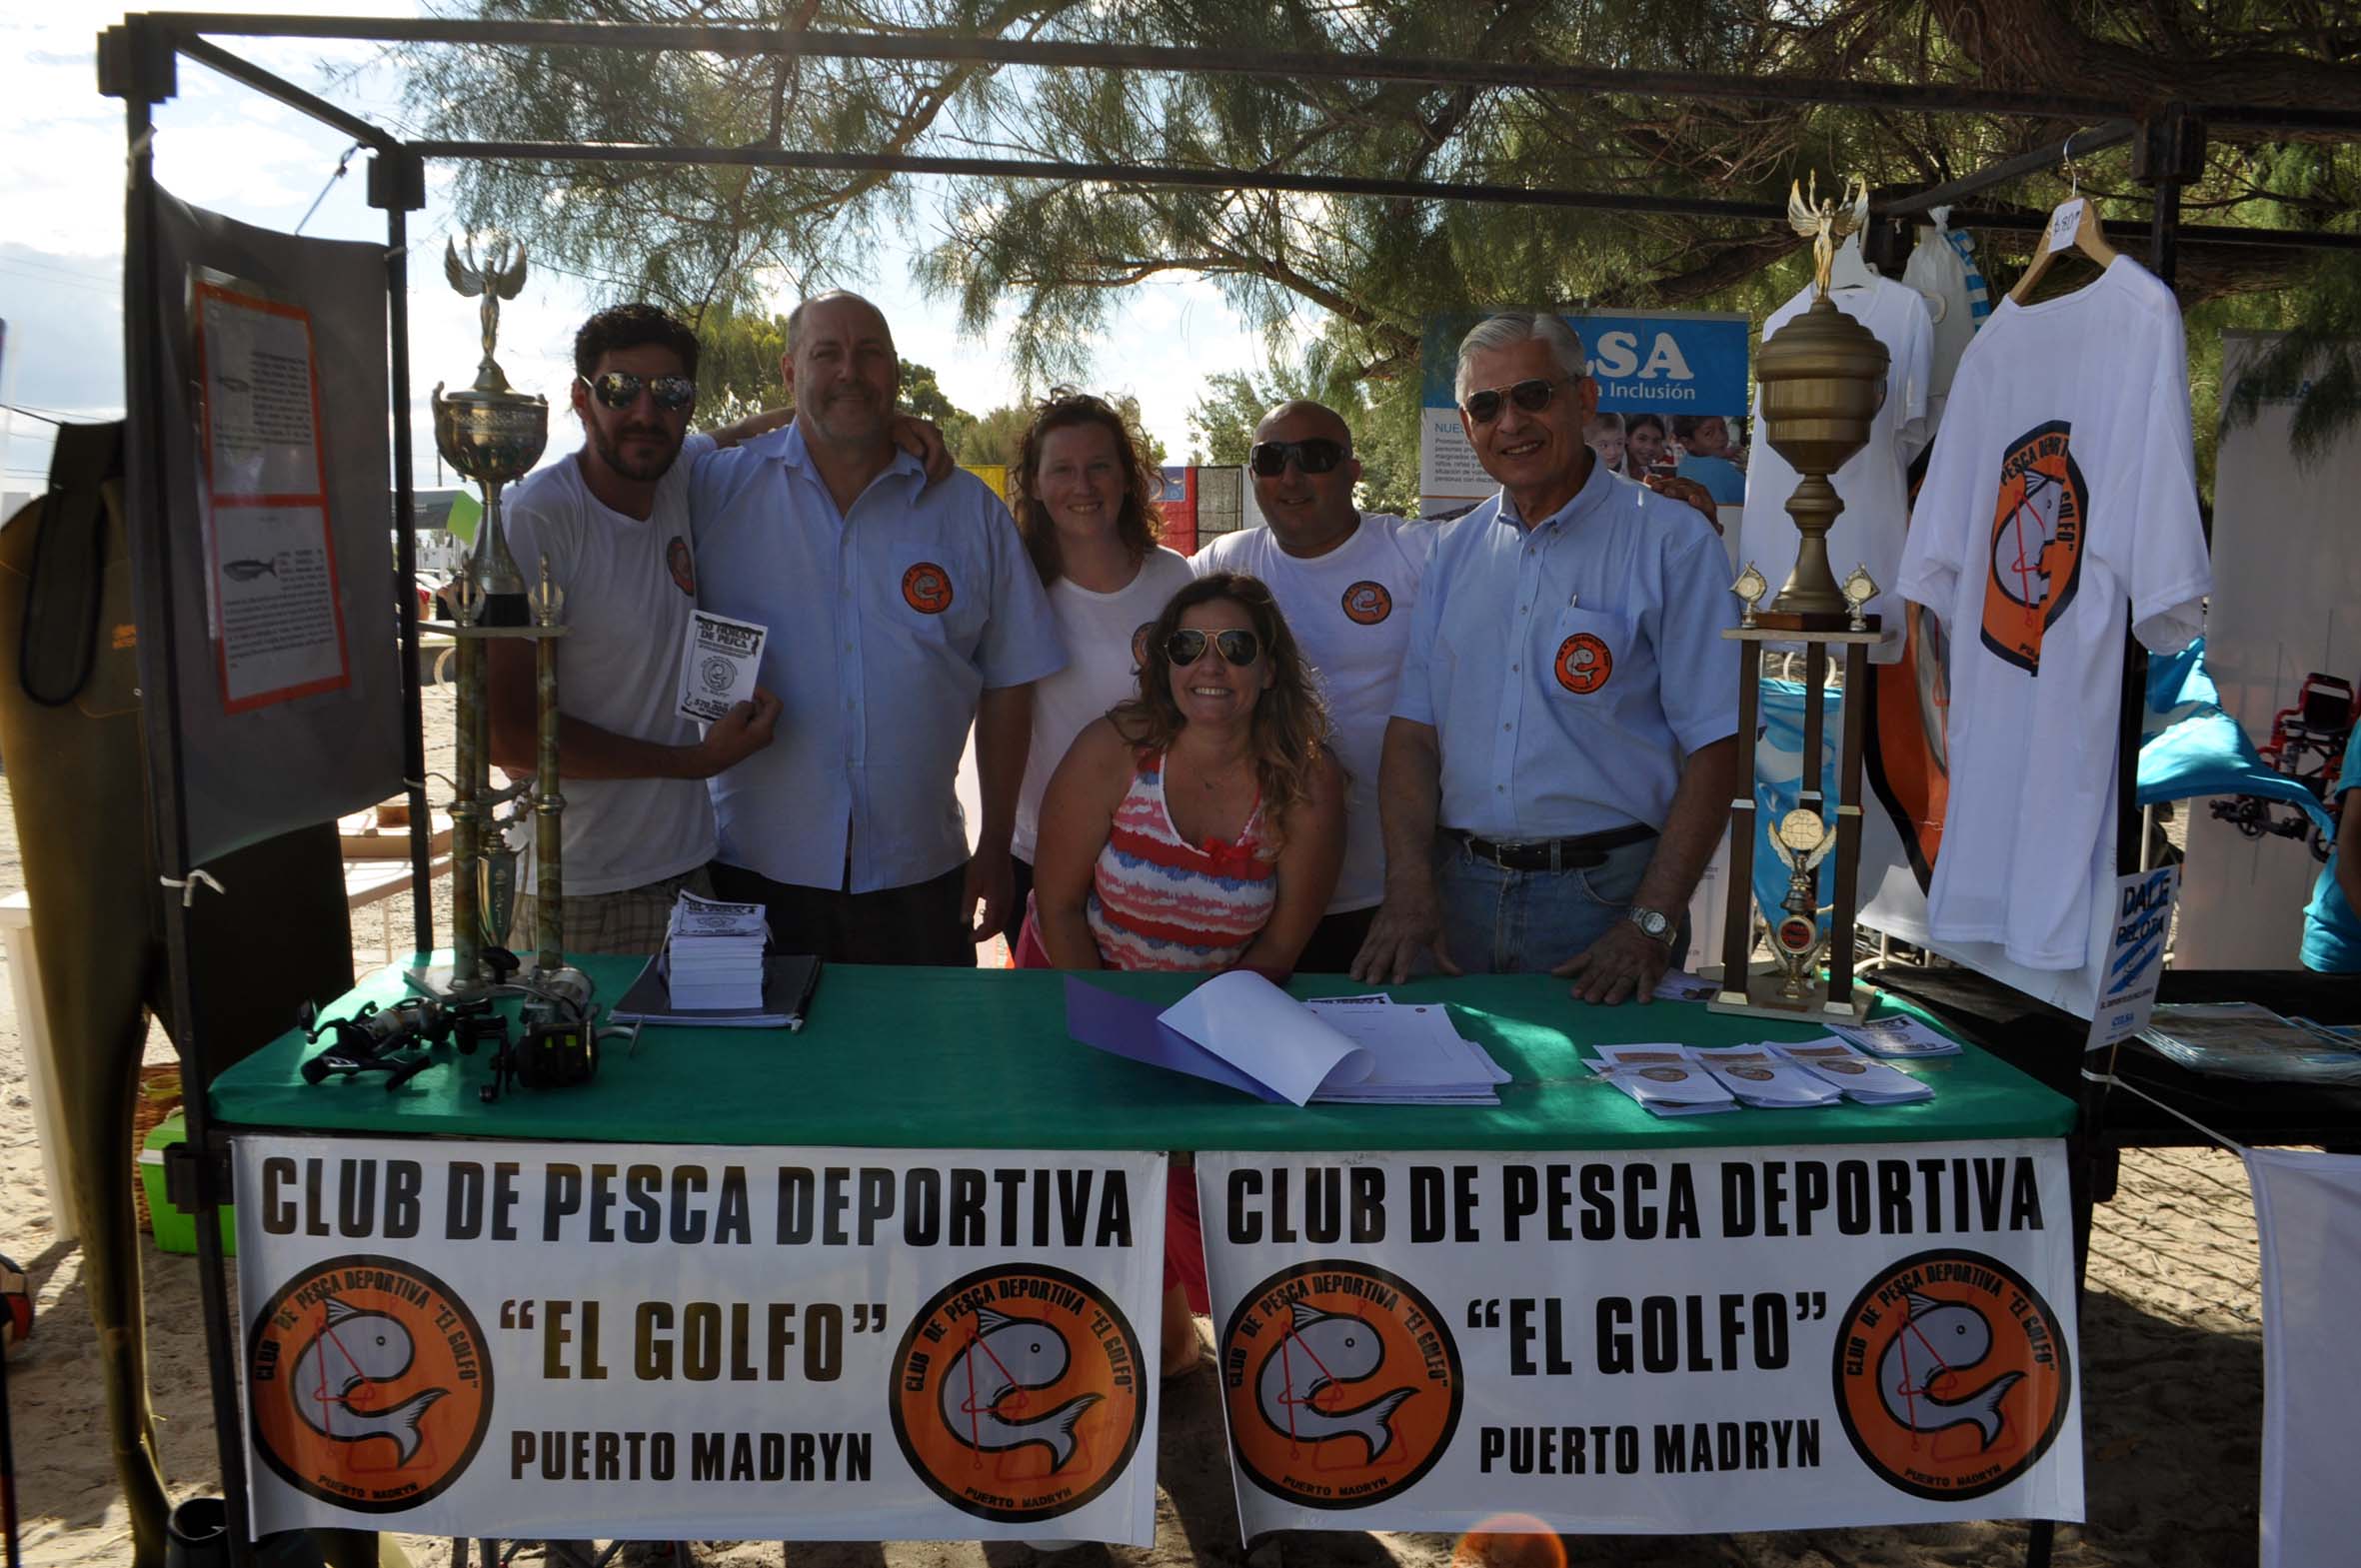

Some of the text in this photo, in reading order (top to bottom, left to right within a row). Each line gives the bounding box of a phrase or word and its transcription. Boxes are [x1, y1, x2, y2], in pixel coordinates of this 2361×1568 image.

[1582, 331, 1695, 380] SA
[1610, 382, 1695, 400] Inclusión
[2000, 447, 2037, 487] PESCA
[2122, 877, 2171, 917] DALE
[262, 1157, 1133, 1247] CLUB DE PESCA DEPORTIVA
[1226, 1156, 2044, 1244] CLUB DE PESCA DEPORTIVA
[256, 1339, 282, 1381] CLUB
[274, 1305, 299, 1331] DE
[295, 1277, 343, 1310] PESCA
[344, 1270, 432, 1309] DEPORTIVA
[500, 1300, 888, 1382] “EL GOLFO”
[906, 1351, 931, 1392] CLUB
[923, 1319, 949, 1344] DE
[944, 1287, 996, 1322] PESCA
[998, 1278, 1087, 1316] DEPORTIVA
[1229, 1347, 1247, 1388] CLUB
[1239, 1314, 1263, 1339] DE
[1259, 1282, 1310, 1317] PESCA
[1311, 1275, 1400, 1312] DEPORTIVA
[1466, 1291, 1827, 1376] “EL GOLFO”
[1846, 1336, 1867, 1377] CLUB
[1859, 1305, 1883, 1329] DE
[1877, 1269, 1924, 1308] PESCA
[1926, 1263, 2003, 1296] DEPORTIVA
[511, 1431, 872, 1481] PUERTO MADRYN
[1479, 1418, 1821, 1475] PUERTO MADRYN
[318, 1474, 366, 1498] PUERTO
[965, 1487, 1073, 1508] PUERTO MADRYN
[1282, 1475, 1388, 1496] PUERTO MADRYN
[1904, 1463, 2003, 1487] PUERTO MADRYN
